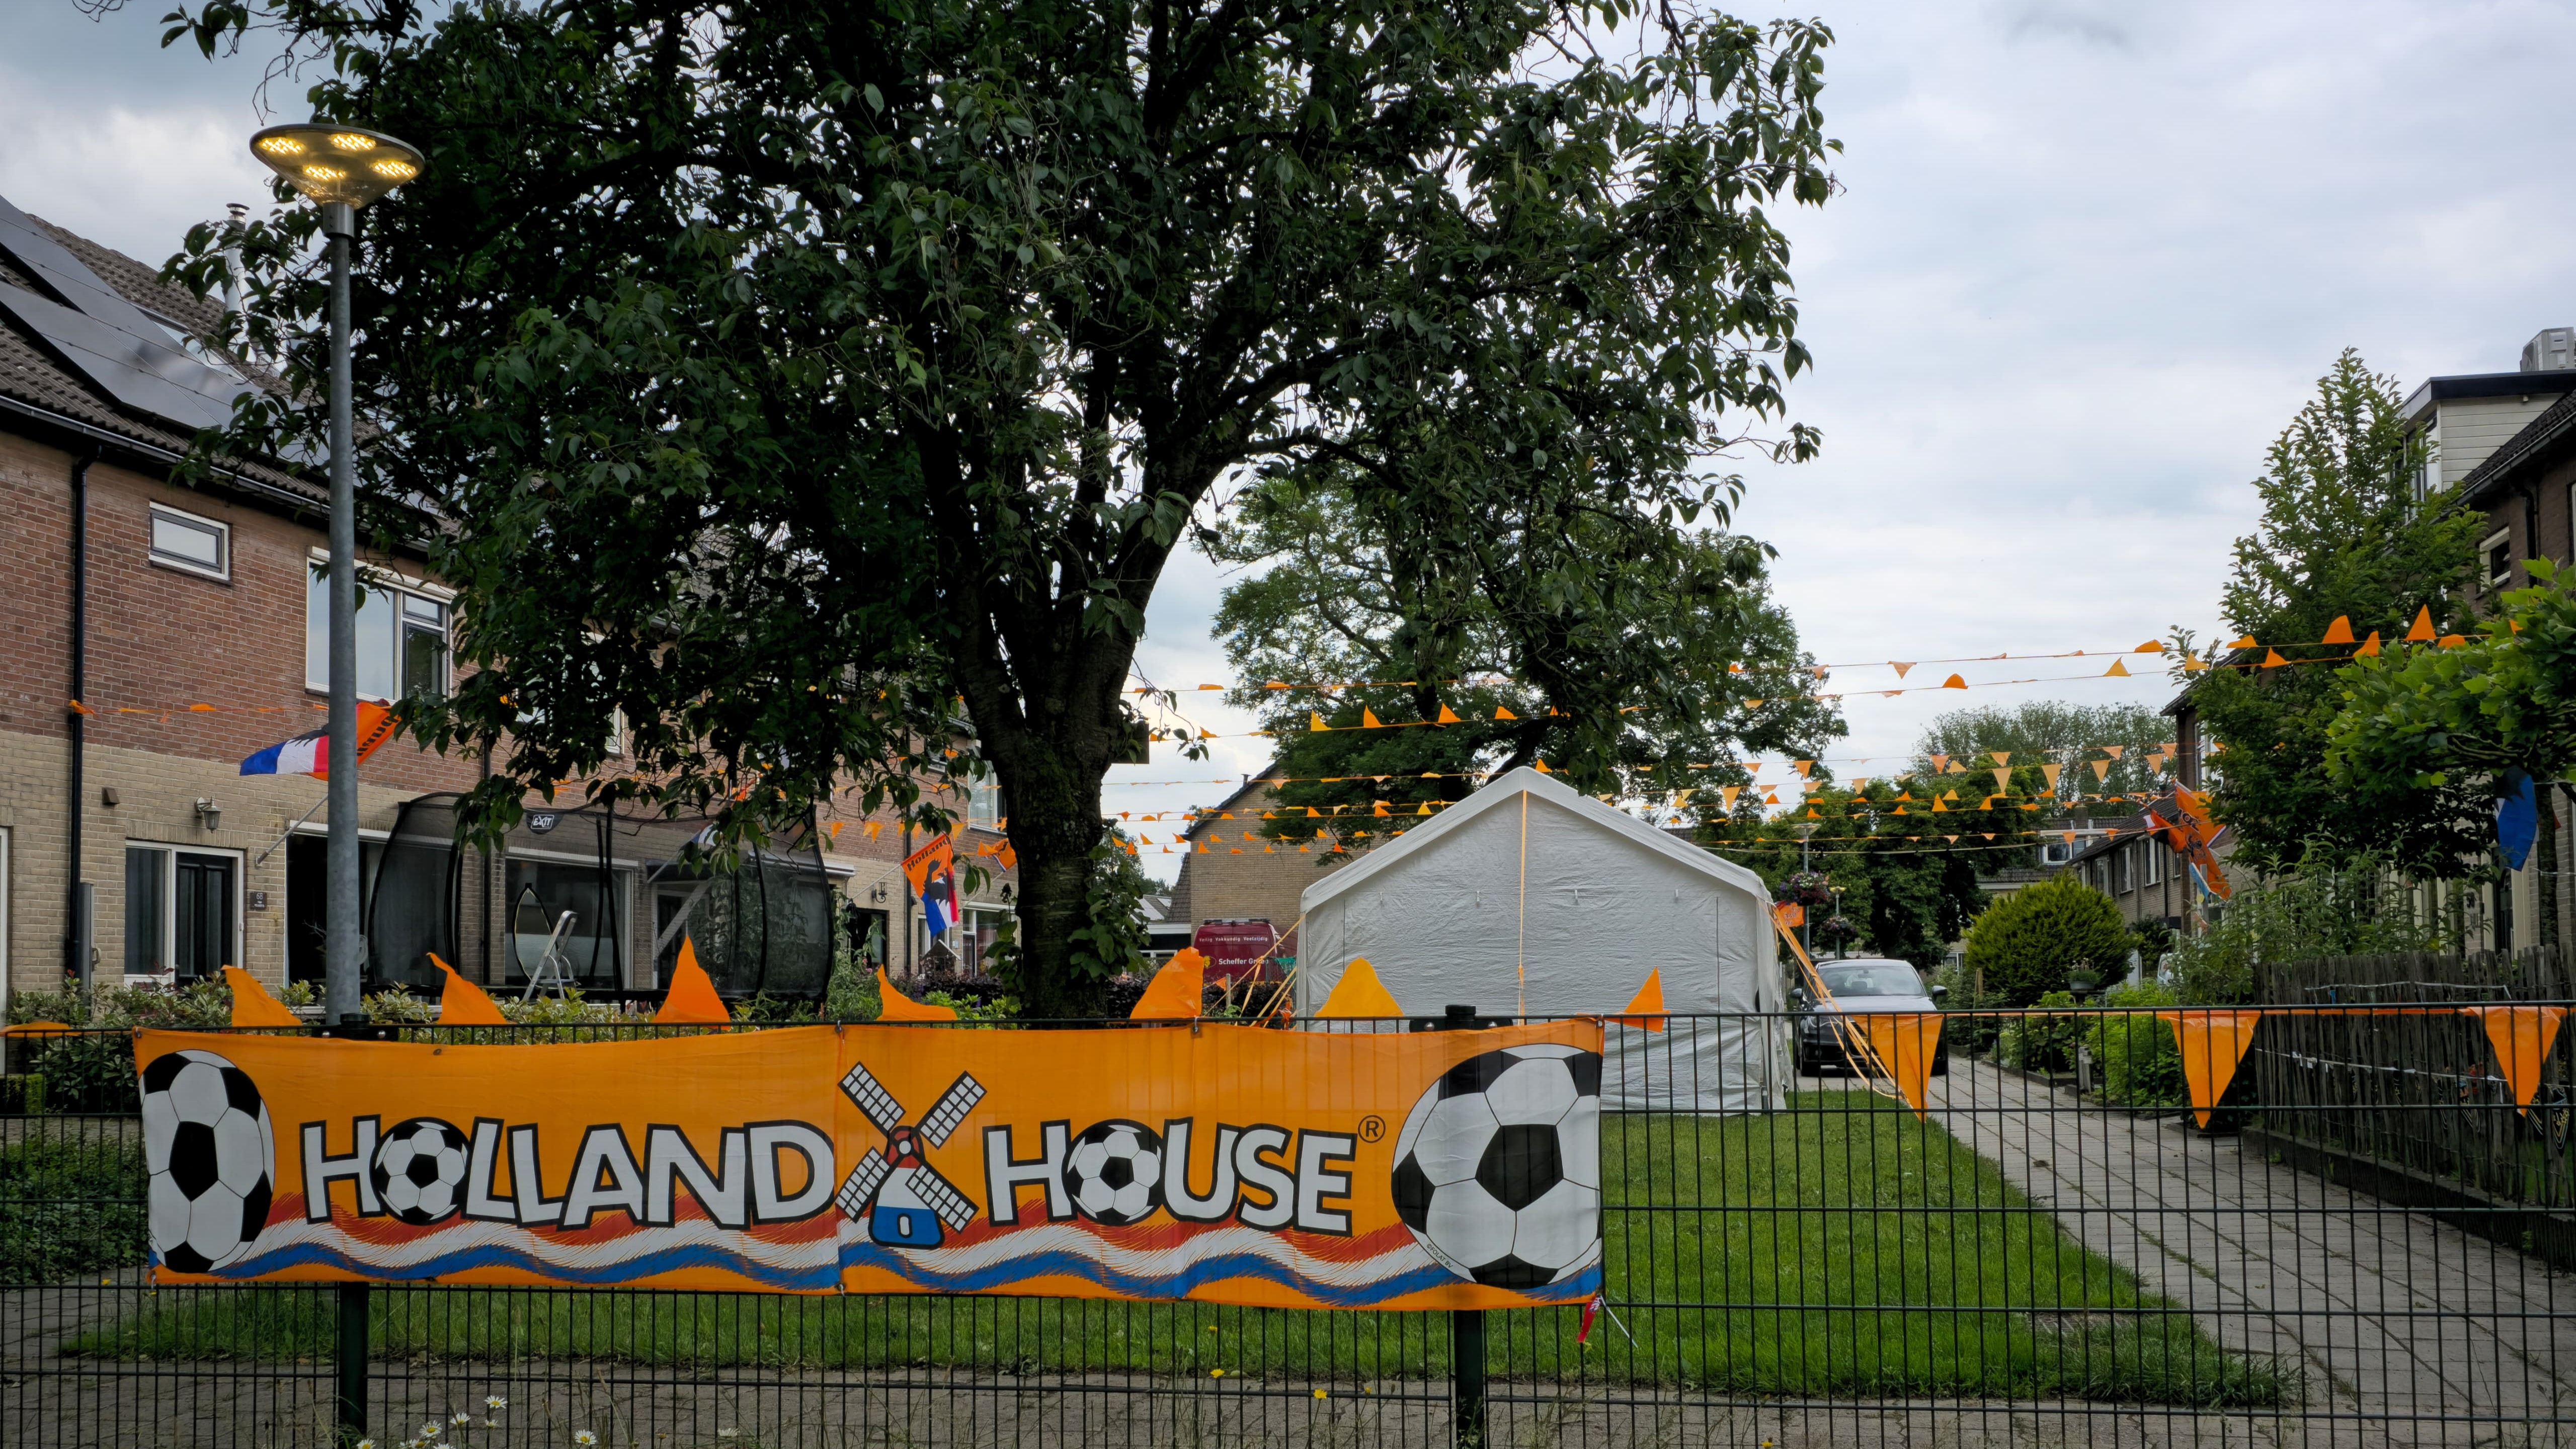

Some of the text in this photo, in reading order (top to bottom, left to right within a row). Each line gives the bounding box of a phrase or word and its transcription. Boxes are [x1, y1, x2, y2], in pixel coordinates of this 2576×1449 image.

[533, 816, 552, 828] EXIT
[907, 836, 950, 871] Holland
[300, 1113, 834, 1231] HOLLAND
